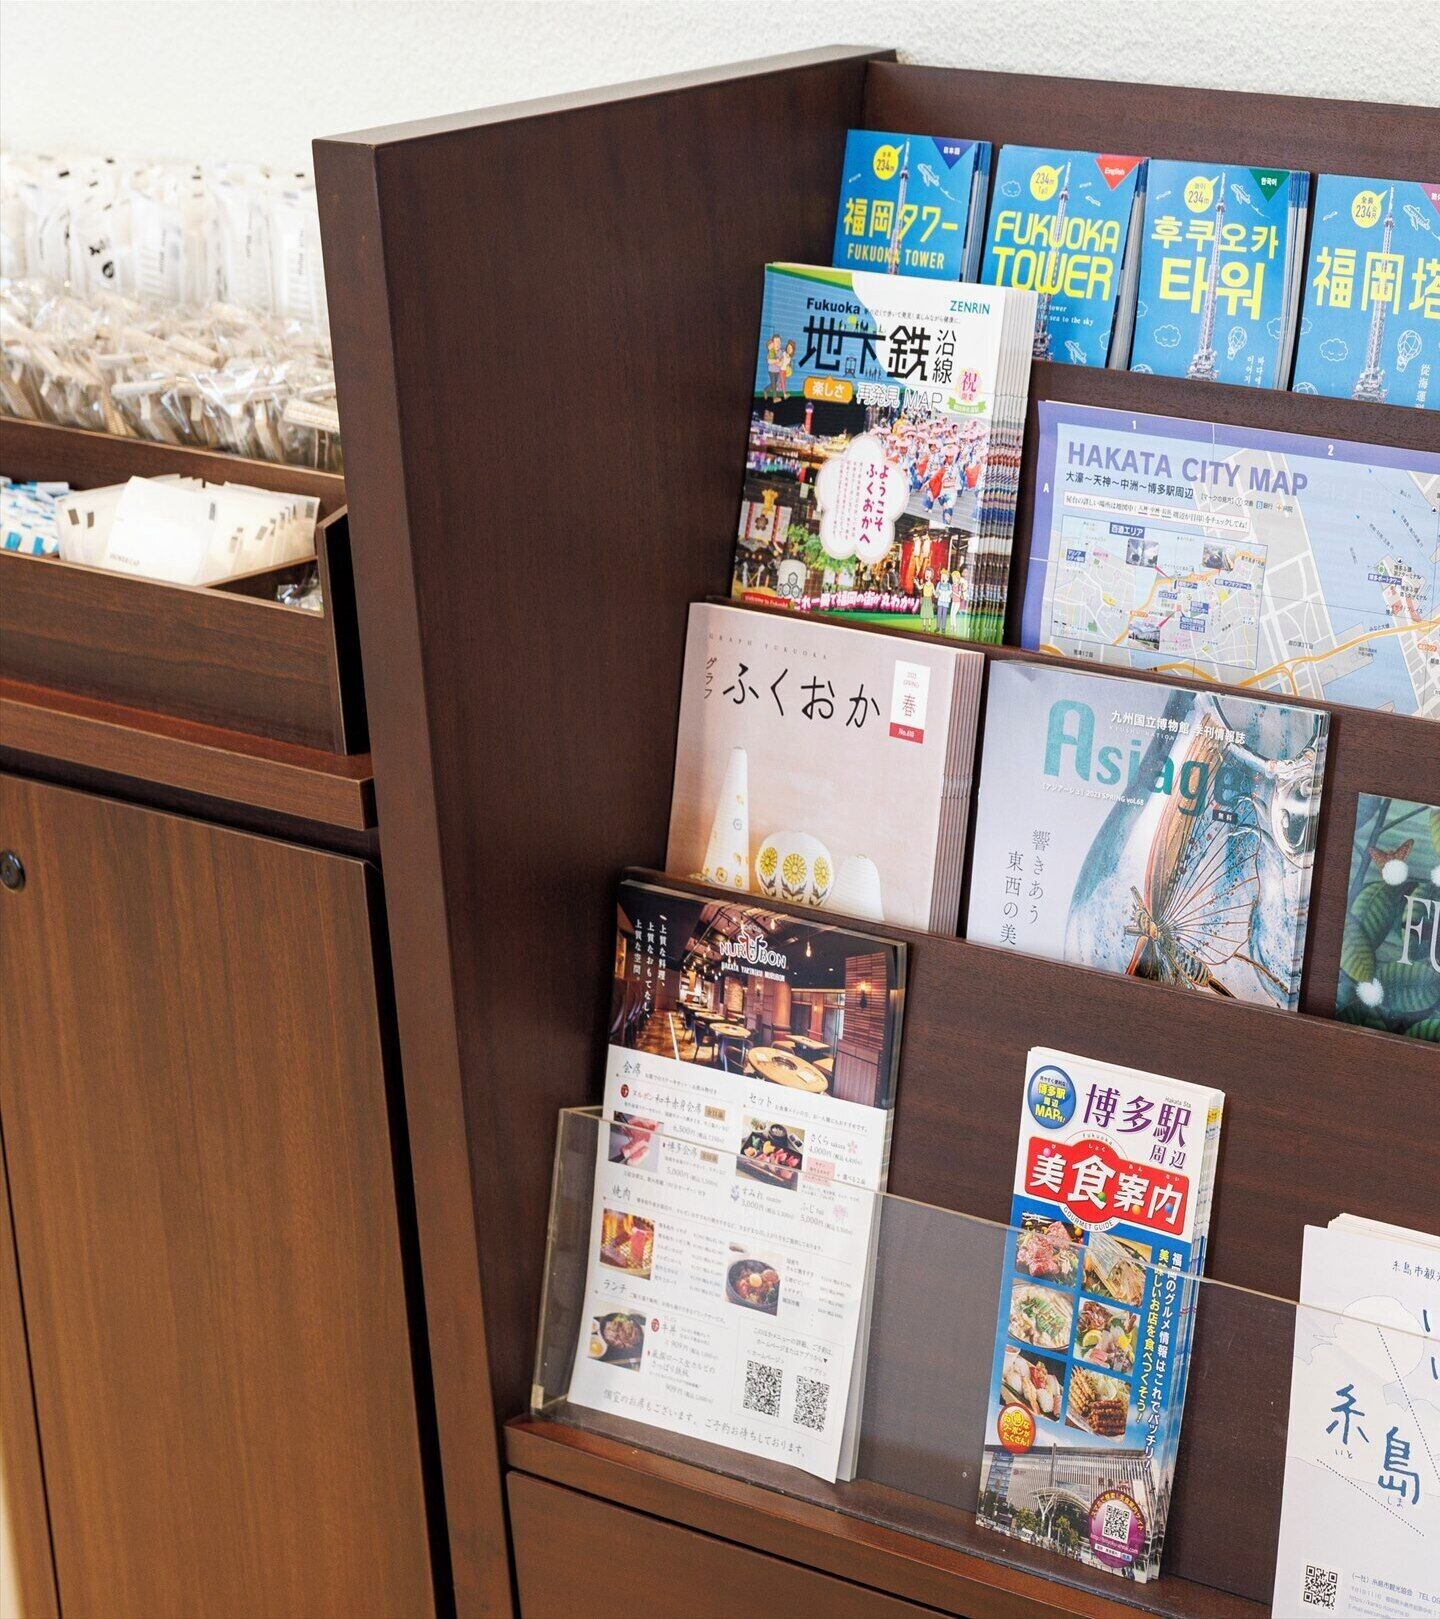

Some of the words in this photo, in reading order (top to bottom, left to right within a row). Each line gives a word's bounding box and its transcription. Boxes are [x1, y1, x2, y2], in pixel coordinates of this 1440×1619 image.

[1104, 166, 1126, 176] English
[1261, 176, 1278, 187] 한국어
[843, 197, 958, 243] 福岡タワー
[994, 210, 1120, 254] FUKUOKA
[1151, 215, 1279, 259] 후쿠오카
[847, 242, 900, 265] FUKUOKA
[905, 249, 945, 269] TOWER
[992, 246, 1115, 301] TOWER
[1159, 256, 1265, 321] 타워
[807, 298, 861, 315] Fukuoka
[950, 300, 991, 315] ZENRIN
[798, 314, 932, 382] 地下鉄
[931, 329, 957, 384] 沿線
[811, 381, 845, 398] 楽しさ
[856, 382, 901, 408] 再発見
[903, 388, 943, 411] MAP
[961, 370, 978, 394] 祝
[1132, 420, 1137, 430] 1
[1327, 444, 1334, 456] 2
[1068, 441, 1172, 479] HAKATA
[1181, 457, 1241, 488] CITY
[1249, 466, 1308, 496] MAP
[860, 463, 877, 543] ふくおかへ
[874, 465, 889, 532] ようこそ
[1043, 482, 1050, 493] A
[704, 657, 718, 699] グラフ
[722, 662, 880, 728] ふくおか
[902, 694, 916, 717] 春
[1111, 710, 1190, 735] 九州国立博物館
[1194, 723, 1246, 745] 季刊情報誌
[1044, 699, 1250, 817] Asiage
[1028, 828, 1050, 926] 響きあう
[1000, 851, 1024, 946] 東西の美
[750, 1092, 772, 1108] セット
[1038, 1082, 1066, 1100] 博多駅
[1083, 1084, 1192, 1148] 博多駅
[1148, 1144, 1186, 1169] 周辺
[1029, 1152, 1183, 1226] 美食案内
[1063, 1206, 1092, 1231] GOURMET
[1093, 1220, 1114, 1231] GUIDE
[604, 1279, 626, 1293] ランチ
[1325, 1384, 1421, 1506] 糸島
[1371, 1578, 1414, 1598] 糸島市観光協会
[1418, 1591, 1431, 1602] TEL
